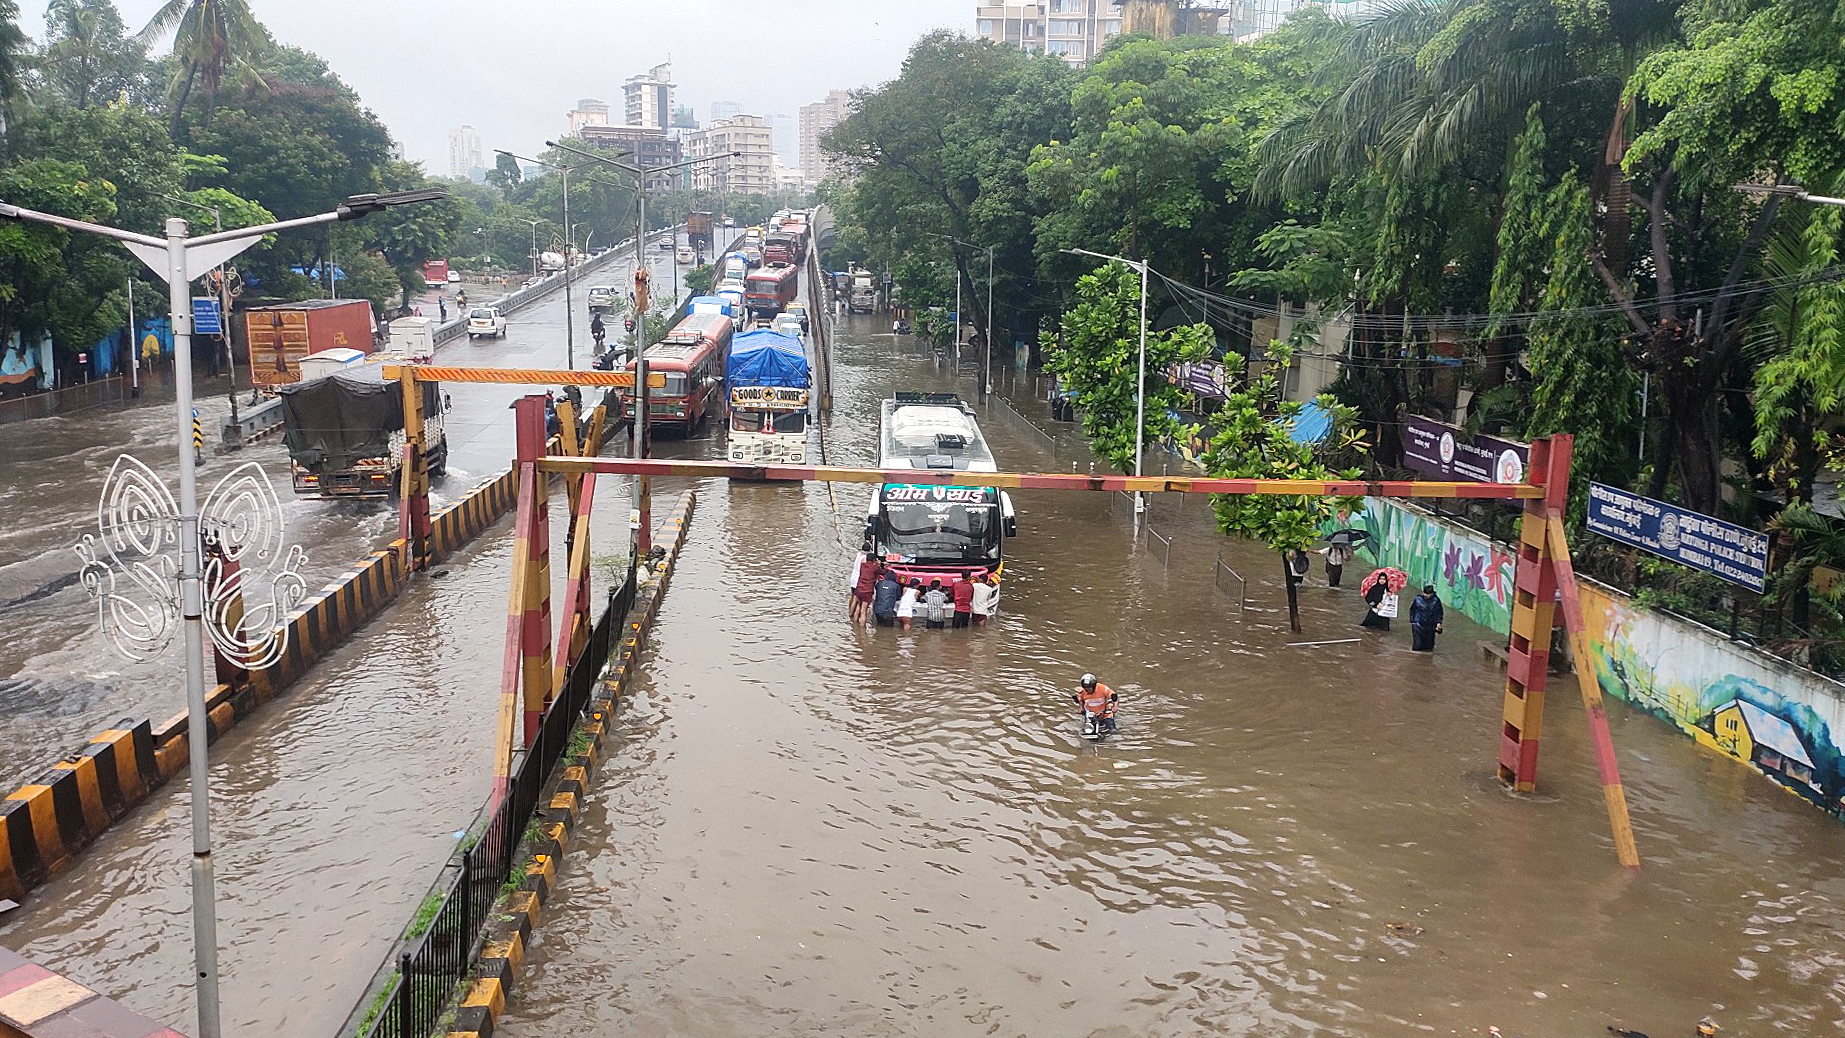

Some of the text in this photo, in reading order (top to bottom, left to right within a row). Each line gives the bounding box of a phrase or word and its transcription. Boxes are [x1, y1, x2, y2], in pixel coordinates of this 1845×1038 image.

[738, 388, 800, 401] GOODS CARRIER
[887, 484, 930, 500] ओम
[1680, 532, 1709, 552] MATUNGA
[1709, 542, 1735, 560] POLICE
